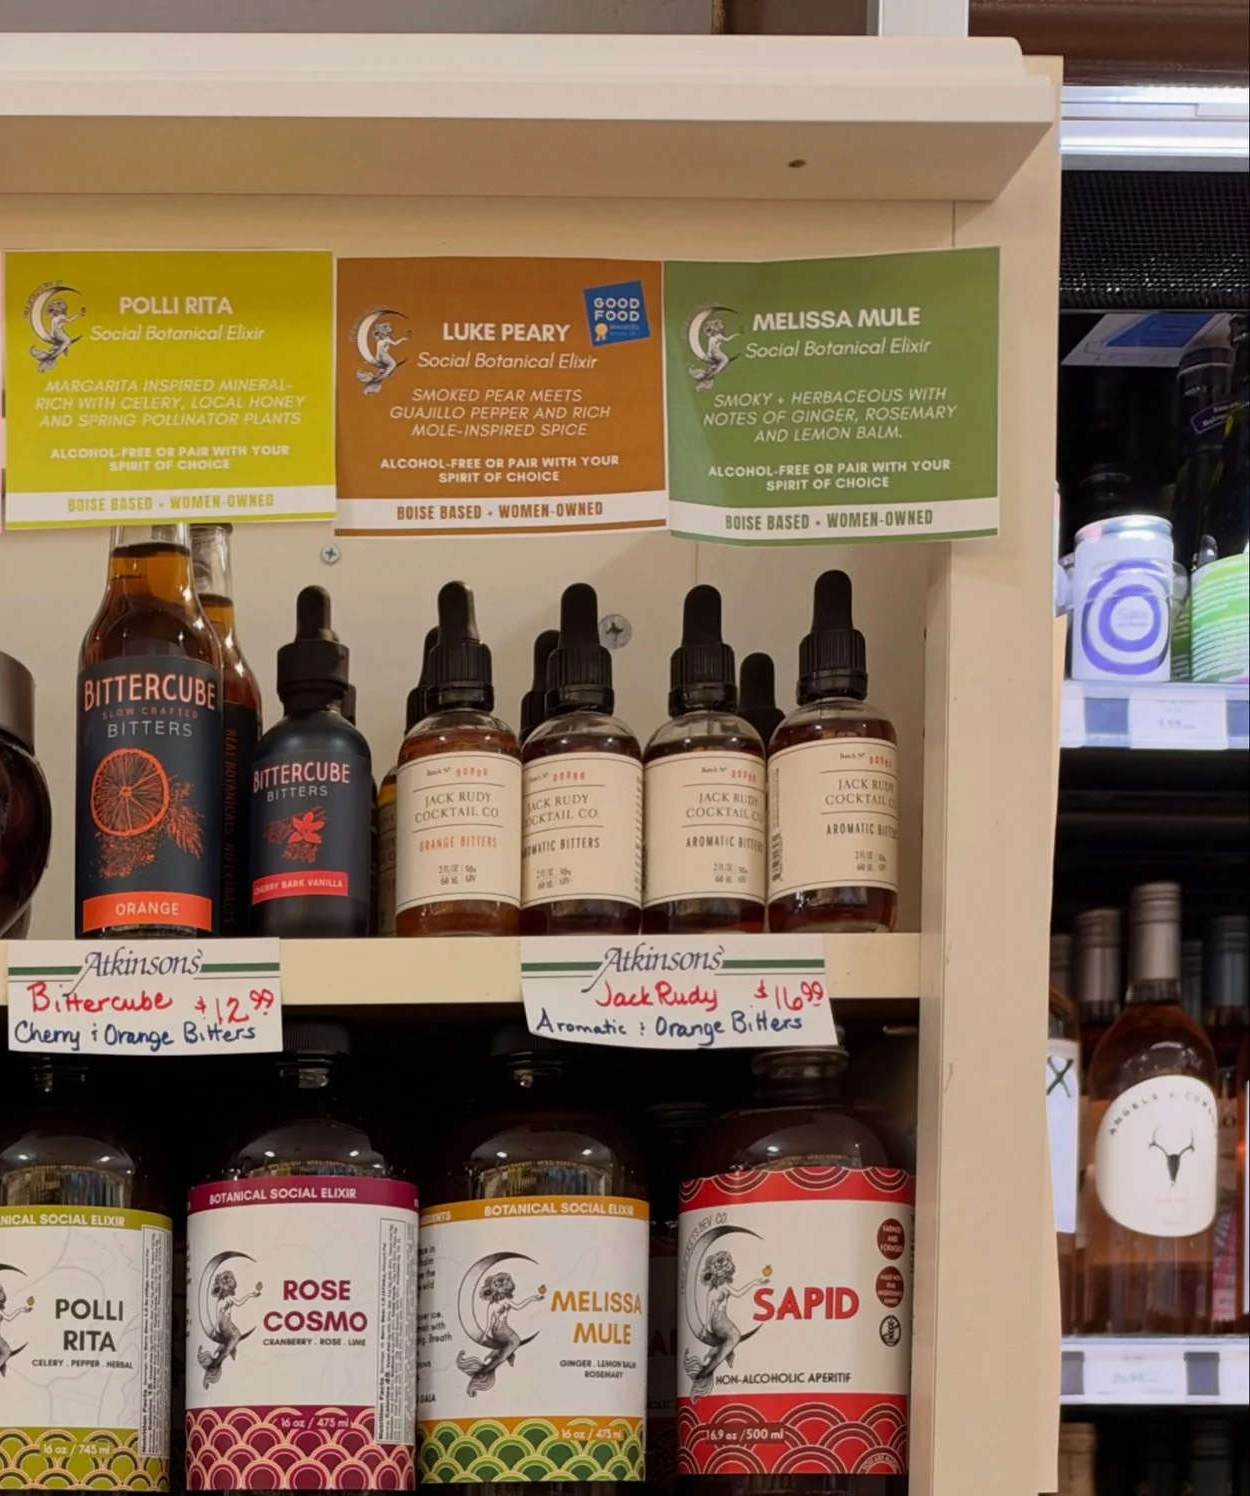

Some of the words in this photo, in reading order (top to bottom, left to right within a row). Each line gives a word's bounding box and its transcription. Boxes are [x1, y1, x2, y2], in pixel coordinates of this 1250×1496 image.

[120, 297, 179, 314] POLLI
[185, 296, 232, 314] RITA
[753, 309, 852, 331] MELISSA
[858, 307, 920, 328] MULE
[443, 323, 495, 341] LUKE
[502, 324, 570, 342] PEARY
[412, 388, 472, 402] SMOKED
[477, 388, 523, 402] PEAR
[529, 388, 582, 402] MEETS
[703, 410, 758, 427] NOTES
[763, 410, 787, 425] OF
[792, 407, 860, 425] GINGER,
[864, 404, 956, 422] ROSEMARY
[725, 513, 764, 531] BOISE
[768, 513, 809, 530] BASED
[827, 510, 933, 528] WOMEN-OWNED
[84, 674, 216, 710] BITTERCUBE
[102, 708, 132, 719] SLOW
[139, 707, 198, 719] CRAFTED
[107, 721, 192, 738] BITTERS
[253, 762, 350, 786] BITTERCUBE
[267, 785, 328, 799] BITTERS
[425, 791, 454, 806] JACK
[458, 790, 492, 803] RUDY
[415, 807, 478, 824] COCKTAIL
[419, 837, 455, 852] ORANGE
[459, 836, 497, 849] BITTERS
[282, 880, 305, 892] BARK
[307, 879, 343, 889] VANILLA
[116, 901, 179, 916] ORANGE
[537, 1008, 628, 1036] Aromatic
[656, 1015, 724, 1045] Orange
[731, 1005, 802, 1032] Bitters
[103, 1023, 174, 1051] Orange
[183, 1022, 256, 1043] Bitters
[40, 1214, 87, 1225] SOCIAL
[91, 1215, 124, 1227] ELIXIR
[283, 1280, 350, 1301] ROSE
[55, 1299, 123, 1320] POLLI
[551, 1291, 642, 1315] MELISSA
[753, 1287, 859, 1322] SAPID
[263, 1311, 368, 1332] COSMO
[63, 1331, 116, 1352] RITA
[573, 1322, 632, 1345] MULE
[716, 1372, 804, 1386] NON-ALCOHOLIC
[807, 1372, 851, 1384] APERITIF
